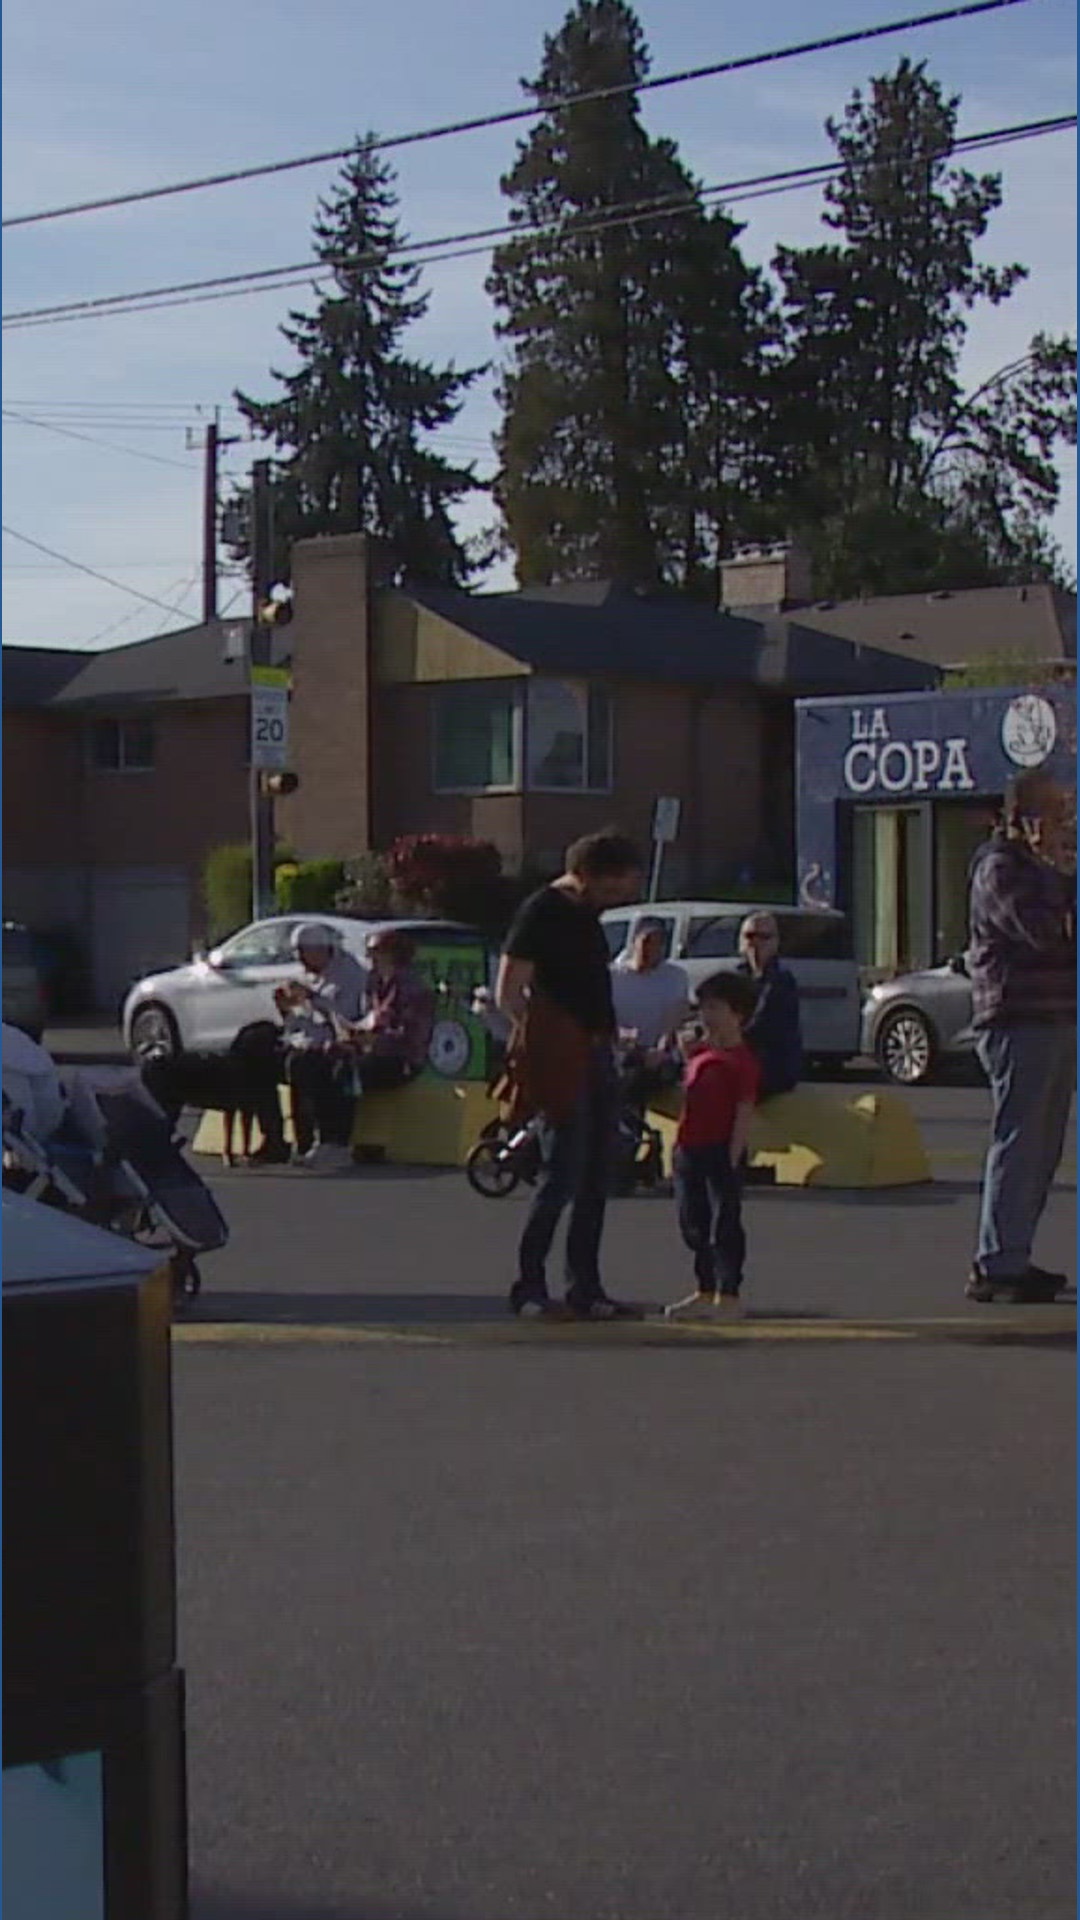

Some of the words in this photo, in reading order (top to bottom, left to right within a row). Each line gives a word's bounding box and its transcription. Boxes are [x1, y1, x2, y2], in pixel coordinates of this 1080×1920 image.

[256, 718, 284, 742] 20
[851, 708, 890, 739] LA
[844, 738, 975, 792] COPA
